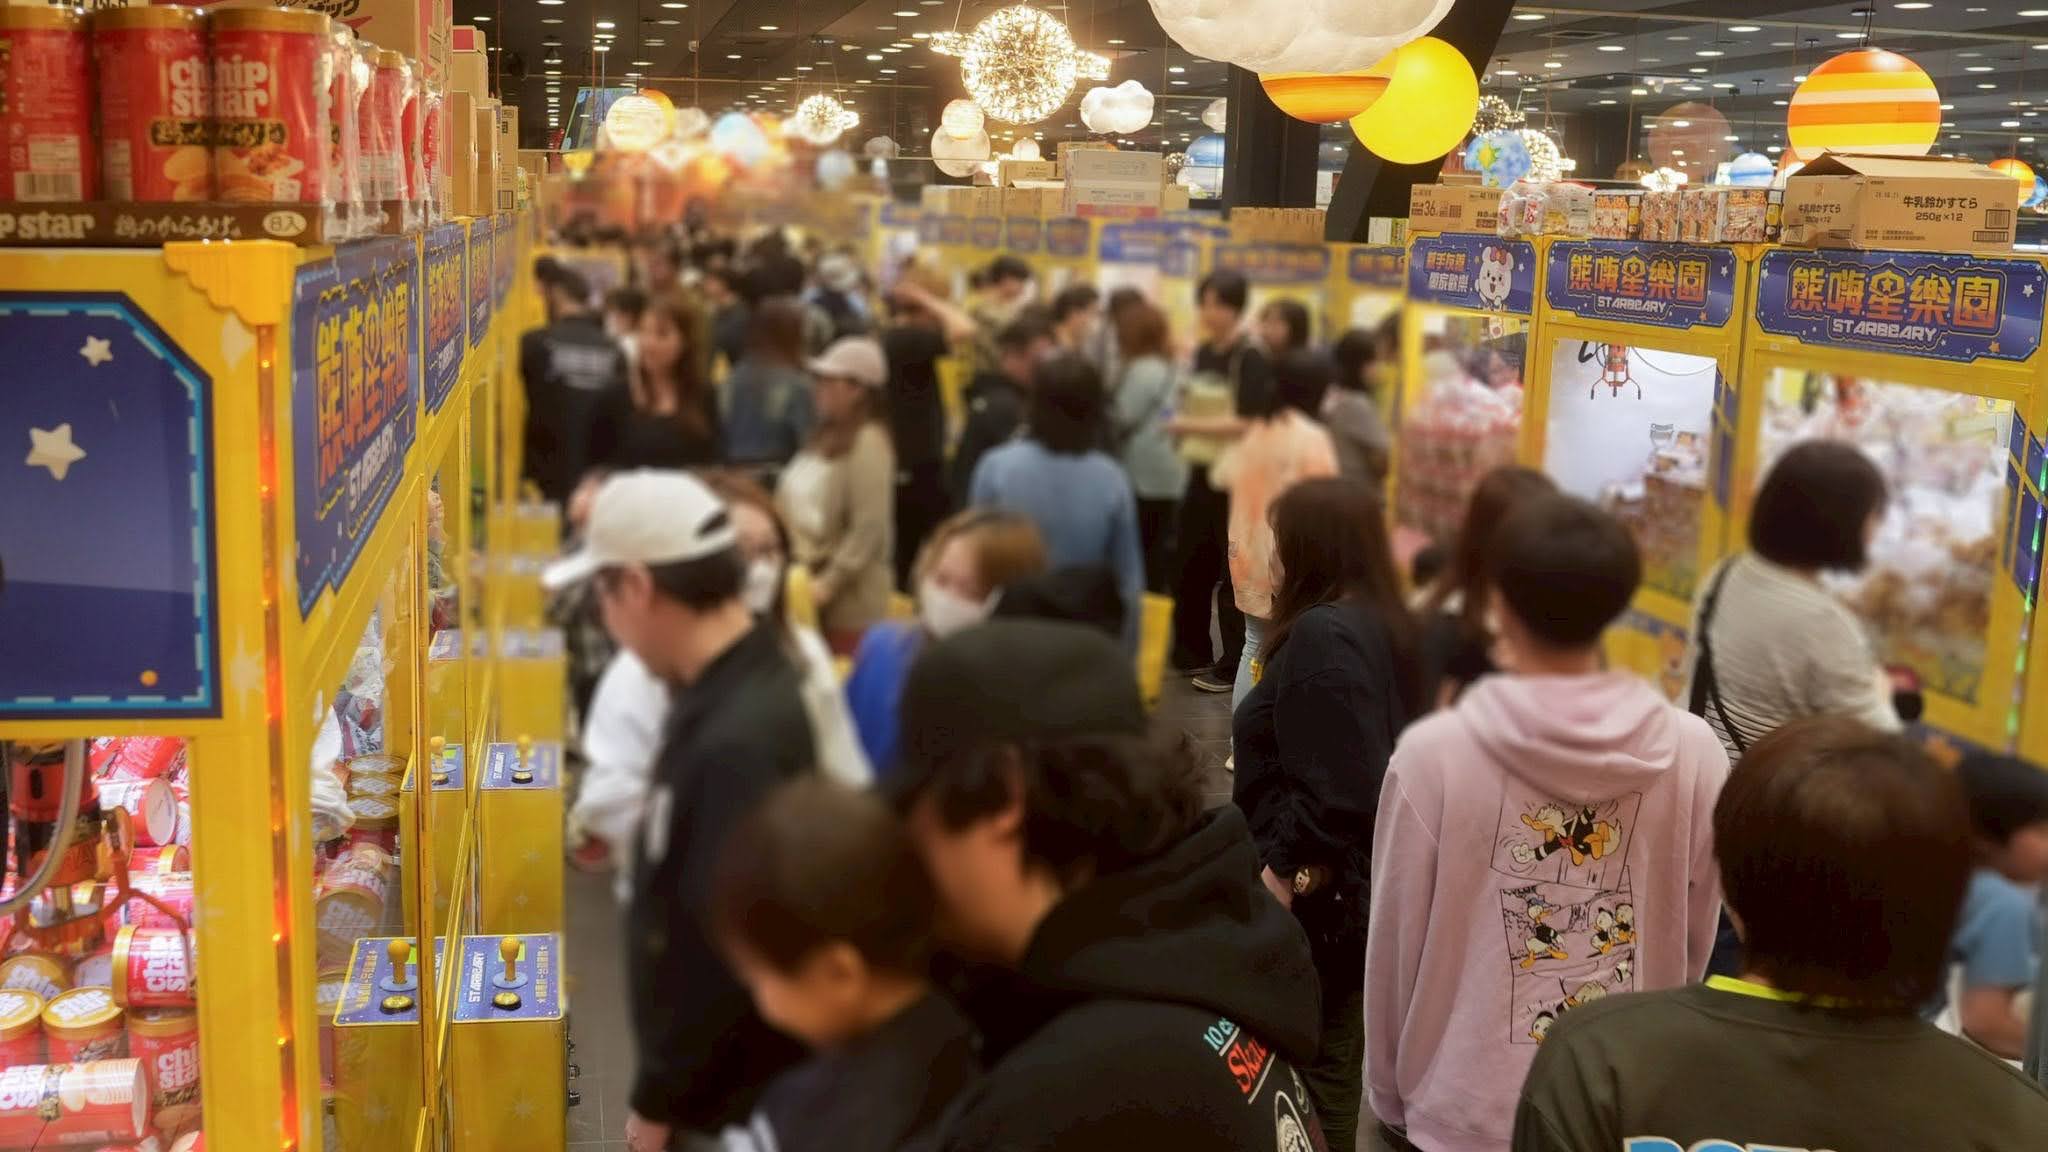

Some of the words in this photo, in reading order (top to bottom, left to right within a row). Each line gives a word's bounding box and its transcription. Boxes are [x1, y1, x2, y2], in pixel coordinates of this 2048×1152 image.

[1903, 196, 1978, 209] 牛乳鈴かすてら
[18, 210, 96, 240] star
[1597, 297, 1667, 314] STARBEARY
[1790, 266, 1999, 329] 熊嗨星樂園
[1832, 318, 1938, 342] STARBEARY
[158, 1041, 200, 1072] chi
[159, 1066, 199, 1091] sta
